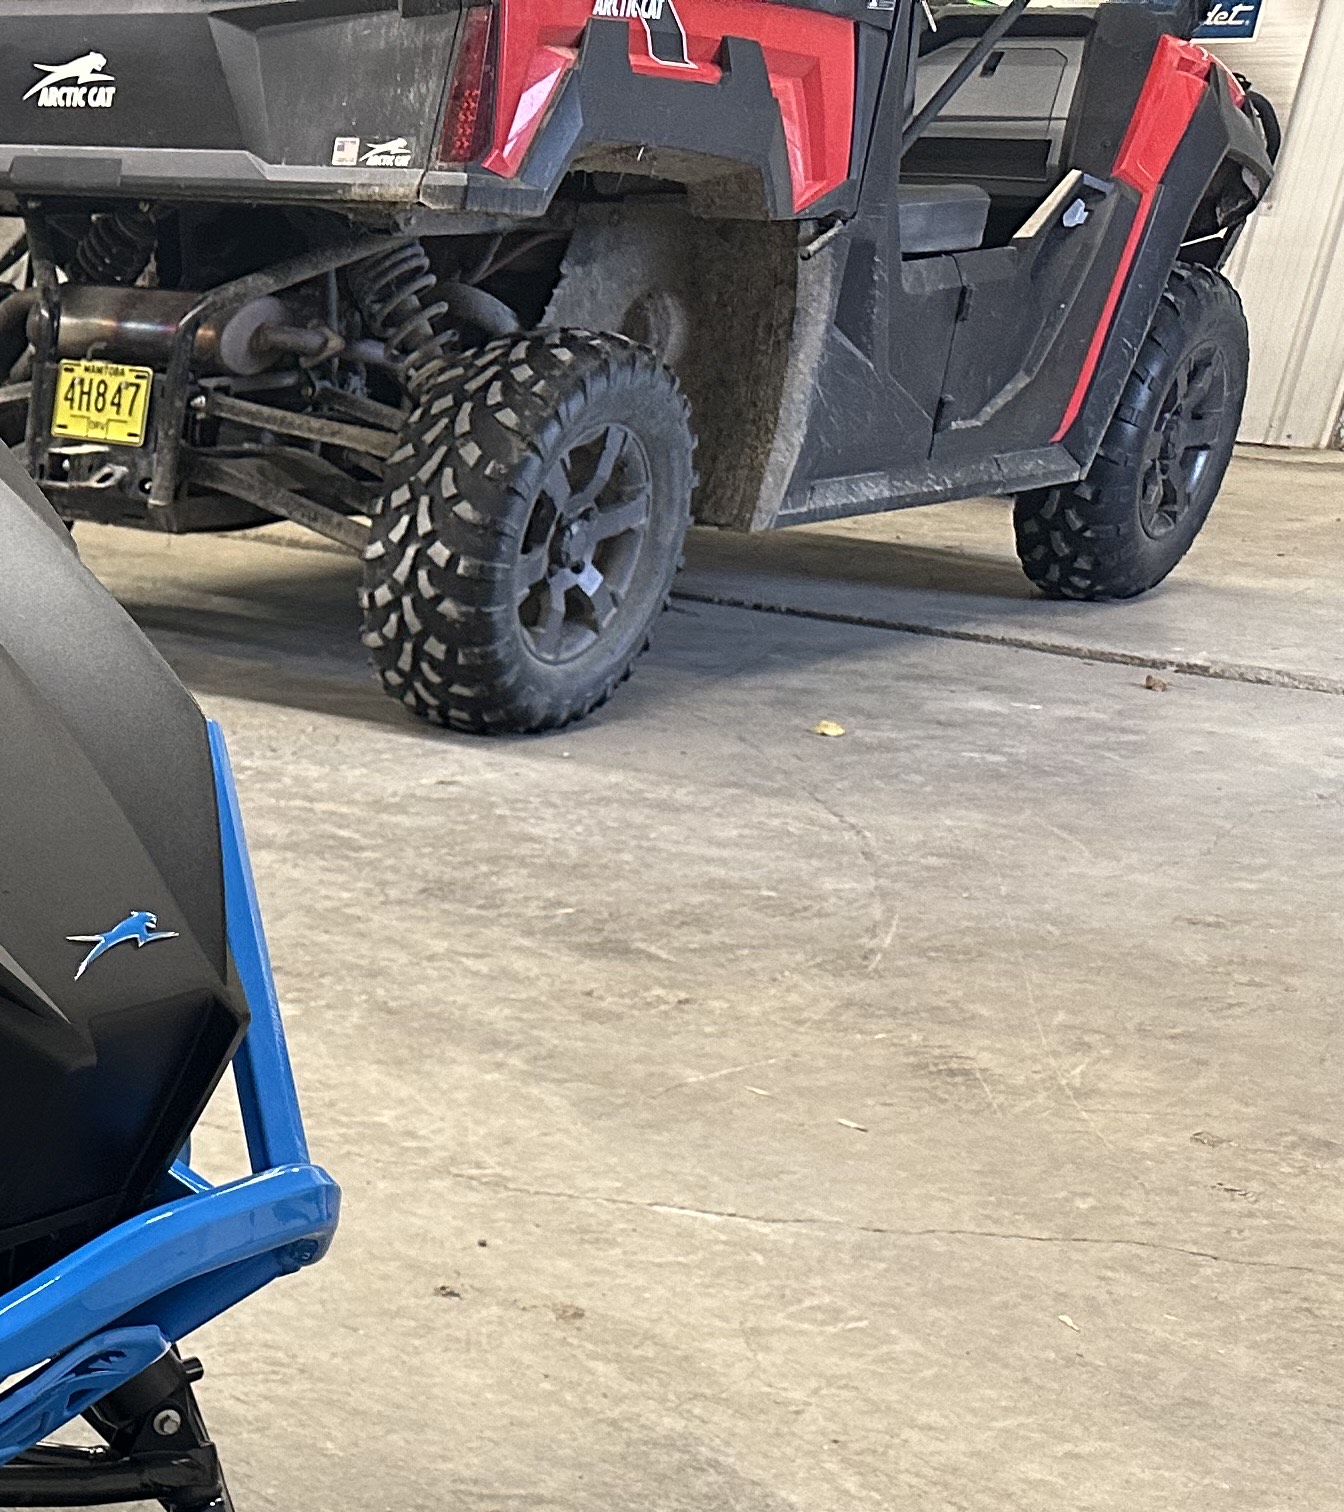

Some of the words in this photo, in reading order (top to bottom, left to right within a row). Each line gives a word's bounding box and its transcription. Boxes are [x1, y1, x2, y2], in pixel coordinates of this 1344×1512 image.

[592, 0, 639, 17] ARCTIC
[640, 0, 665, 19] CAT
[38, 86, 88, 107] ARCTIC
[88, 86, 116, 107] CAT
[64, 377, 141, 416] 4H847
